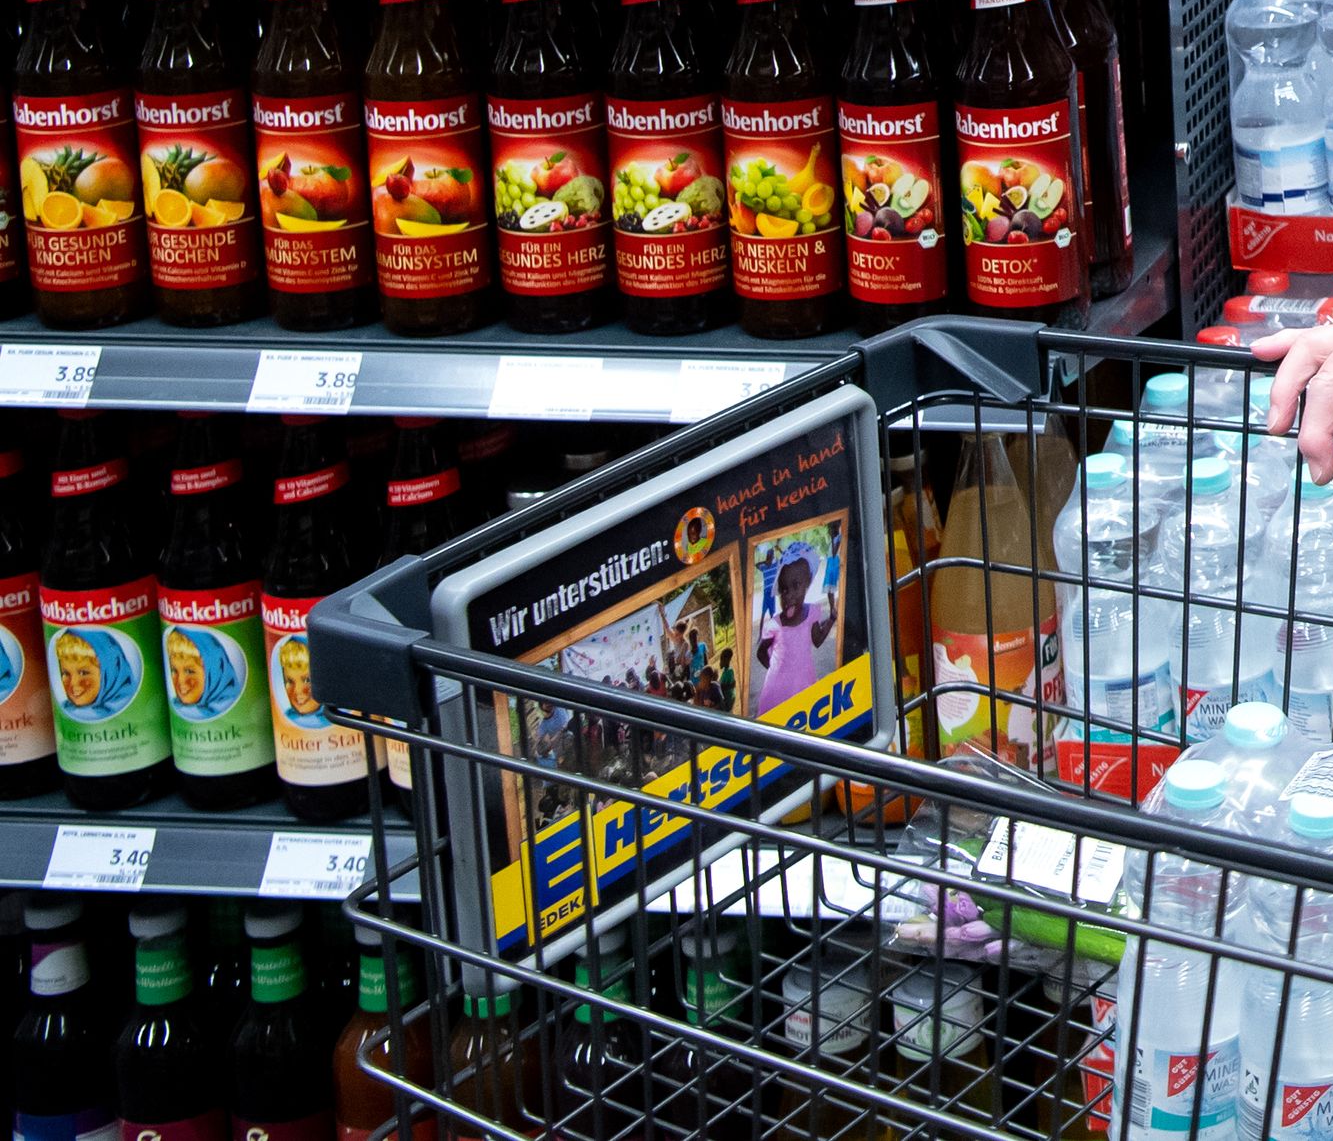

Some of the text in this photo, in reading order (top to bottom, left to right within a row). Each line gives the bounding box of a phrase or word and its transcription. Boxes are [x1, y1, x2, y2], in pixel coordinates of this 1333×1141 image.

[274, 237, 313, 251] FÜR DAS
[393, 243, 437, 257] FÜR DAS
[521, 241, 562, 253] FÜR EIN
[643, 243, 685, 255] FÜR EIN
[748, 240, 826, 257] NERVEN &
[36, 247, 112, 266] KNOCHEN
[567, 244, 606, 266] HERZ
[691, 245, 726, 266] HERZ
[738, 257, 807, 272] MUSKELN
[56, 365, 98, 382] 3.89
[316, 371, 359, 388] 3.89
[716, 433, 845, 515] hand in hand
[737, 506, 769, 536] für
[489, 539, 671, 647] Wir unterstützen:
[110, 849, 151, 867] 3.40
[326, 855, 368, 873] 3.40
[538, 892, 592, 932] EDEK
